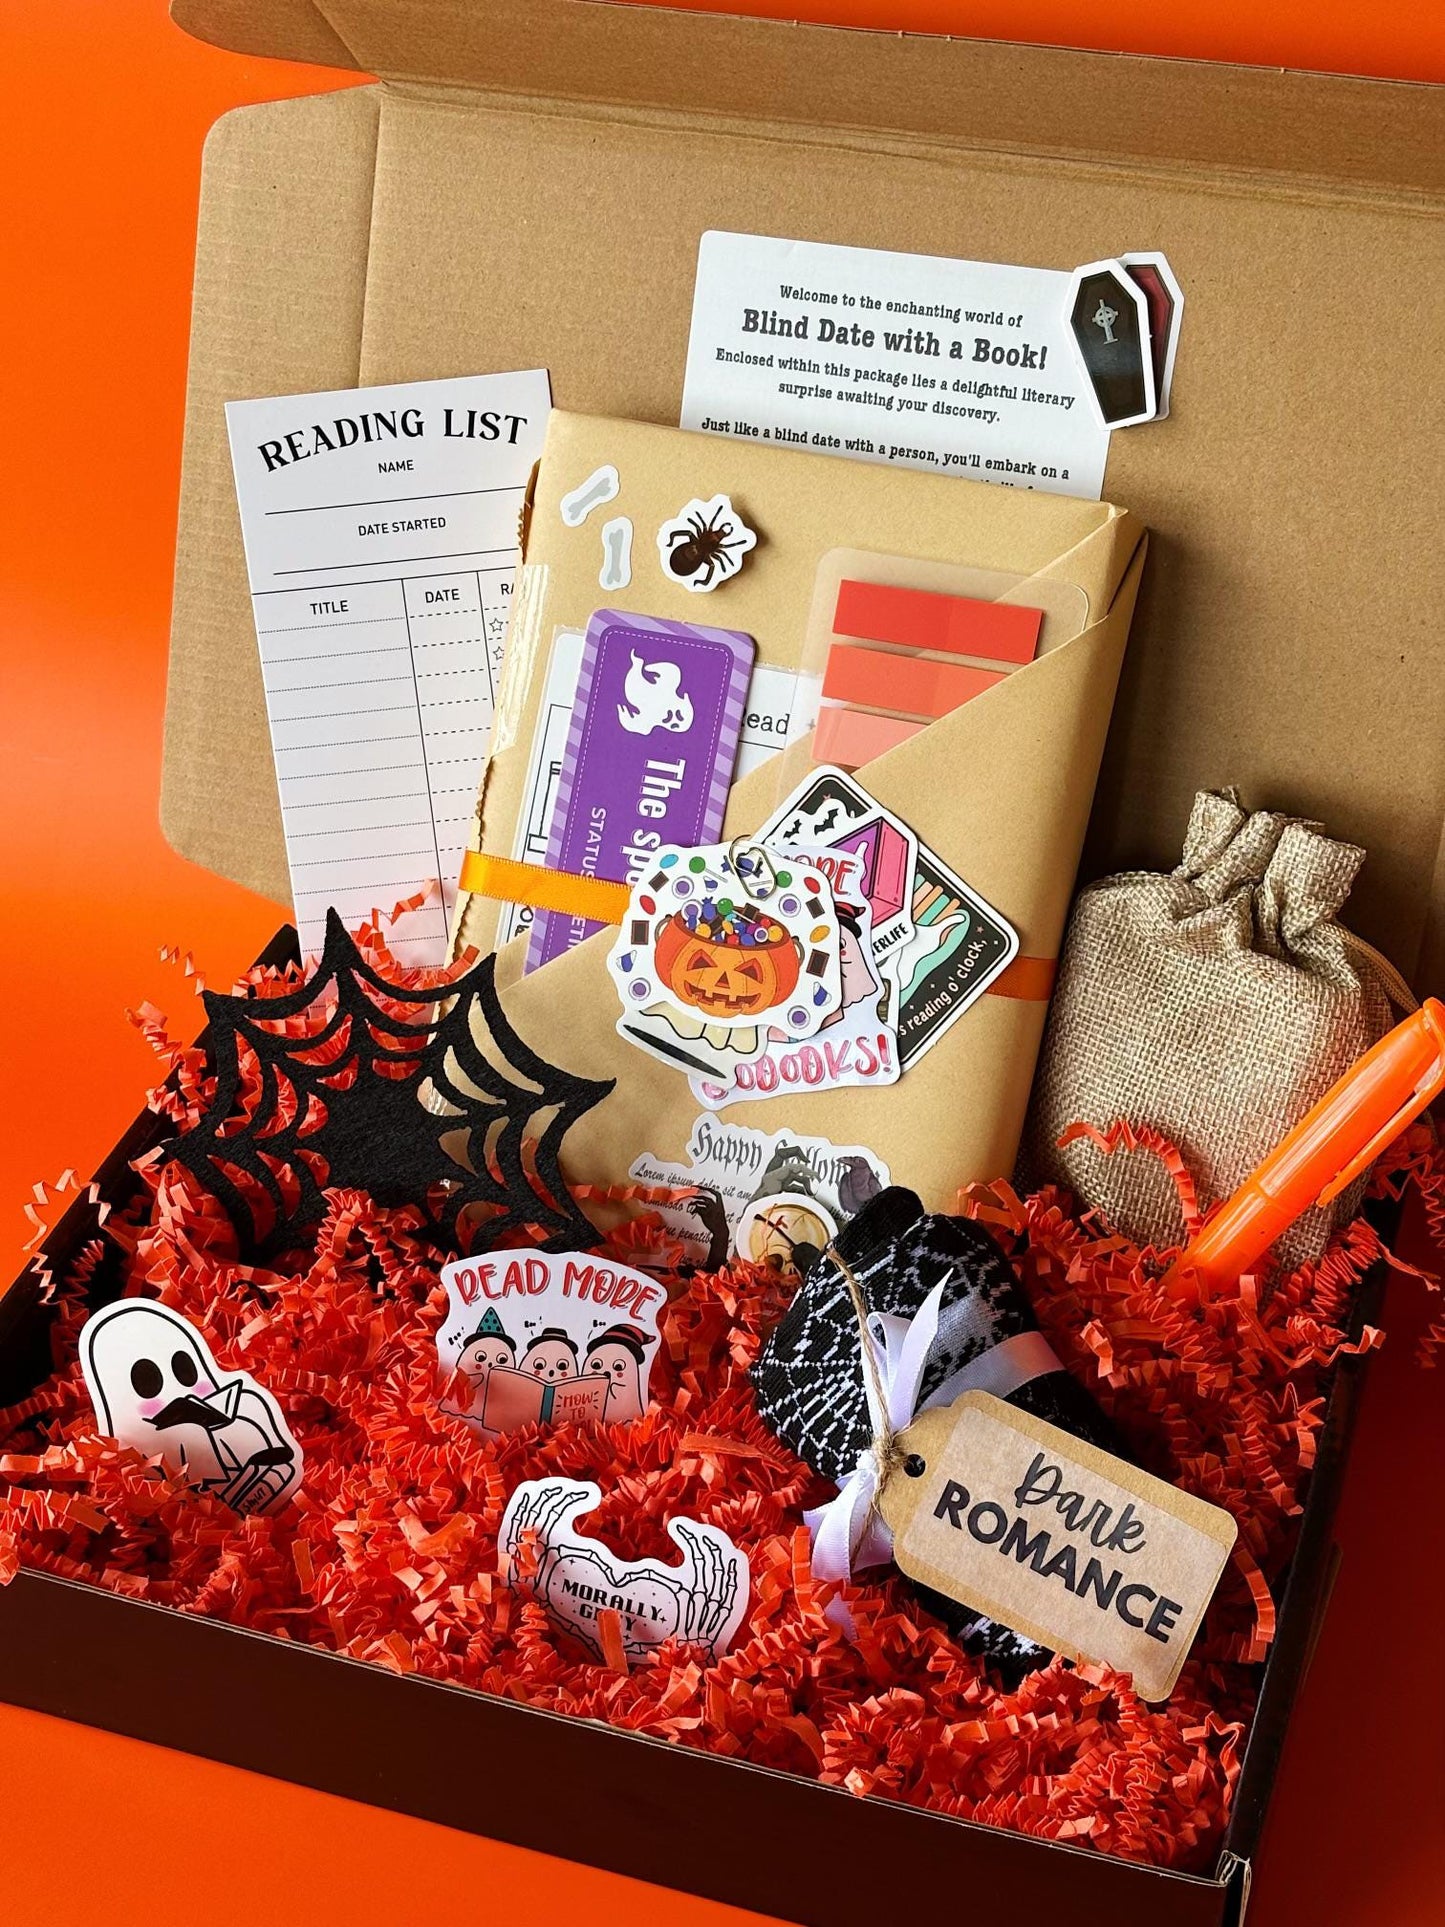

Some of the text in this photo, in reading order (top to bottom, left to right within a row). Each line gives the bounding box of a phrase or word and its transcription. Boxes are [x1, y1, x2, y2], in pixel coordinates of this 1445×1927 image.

[780, 285, 1023, 328] Welcome to the enchanting world of
[742, 309, 1047, 370] Blind Date with a Book!
[716, 348, 1075, 410] Enclosed within this package lies a delightful literary
[779, 383, 1000, 424] surprise awaiting your discovery.
[257, 409, 527, 473] READING LIST
[701, 418, 1069, 480] Just like a blind date with a person, you'll embark on a
[378, 460, 414, 473] NAME
[358, 517, 446, 536] DATE STARTED
[310, 600, 349, 615] TITLE
[425, 589, 460, 603] DATE
[745, 710, 790, 735] ead
[637, 759, 686, 819] The
[872, 922, 908, 957] ERLIFE
[907, 991, 952, 1030] reading
[692, 1122, 762, 1176] Happy
[635, 1162, 665, 1181] Lorem
[454, 1258, 661, 1322] READ MORE
[1014, 1452, 1146, 1553] Dark
[933, 1479, 1183, 1644] ROMANCE
[561, 1578, 662, 1621] MORALLY
[579, 1603, 637, 1631] GY
